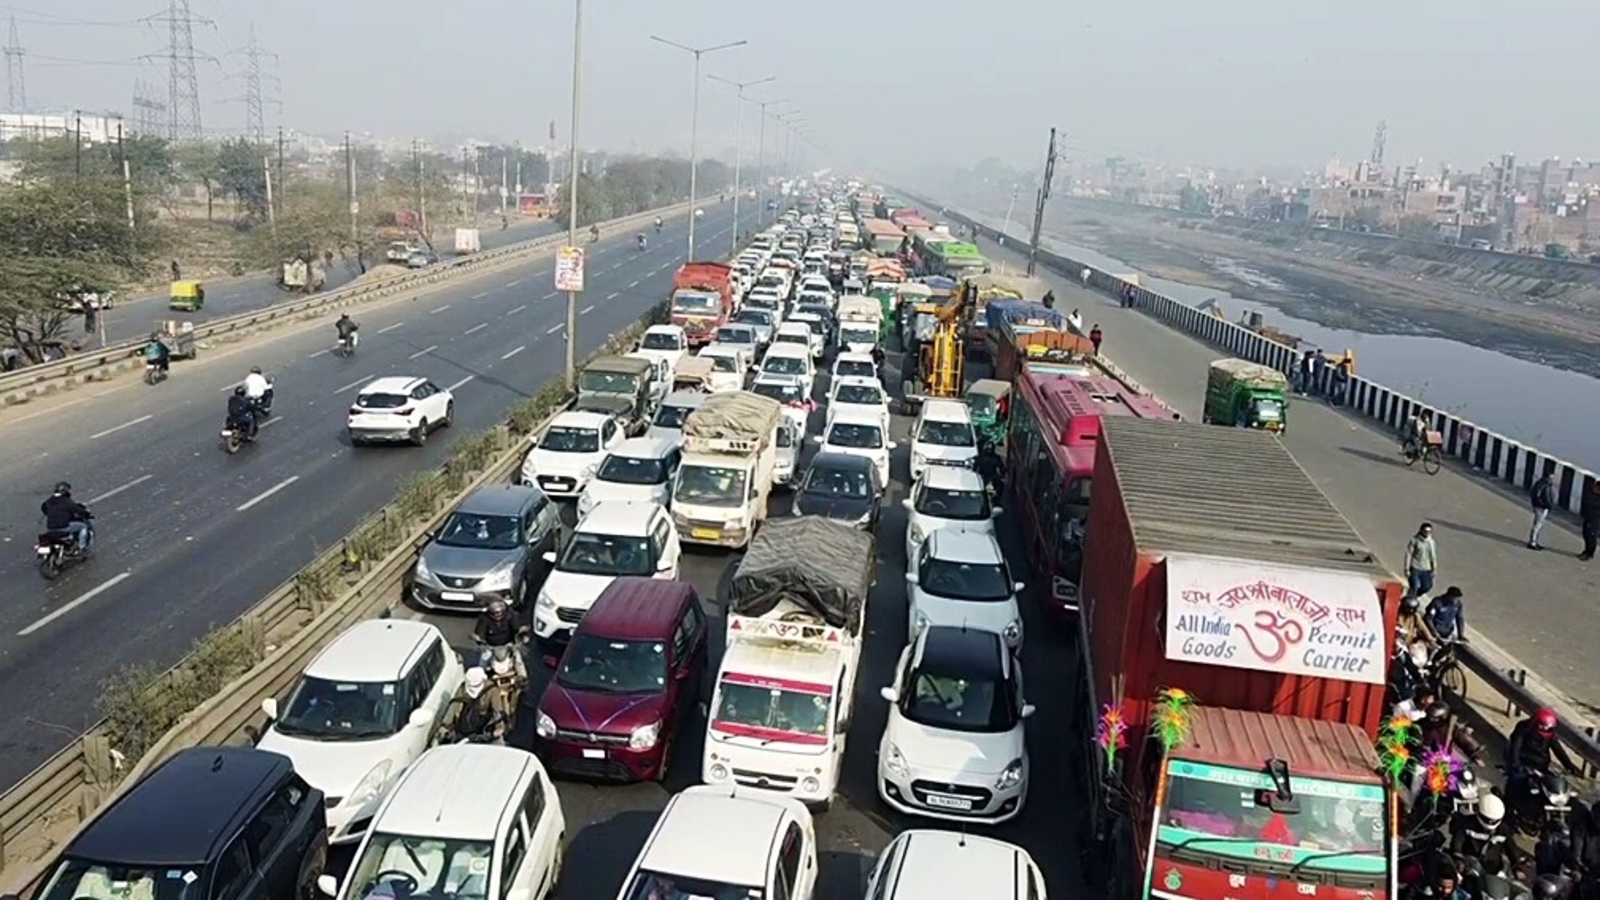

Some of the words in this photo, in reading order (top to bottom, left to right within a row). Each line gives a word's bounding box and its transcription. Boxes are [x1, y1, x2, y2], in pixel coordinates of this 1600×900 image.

[1175, 614, 1199, 634] All
[1200, 615, 1231, 636] India
[1182, 636, 1237, 660] Goods
[1307, 626, 1378, 650] Permit
[1302, 648, 1371, 673] Carrier
